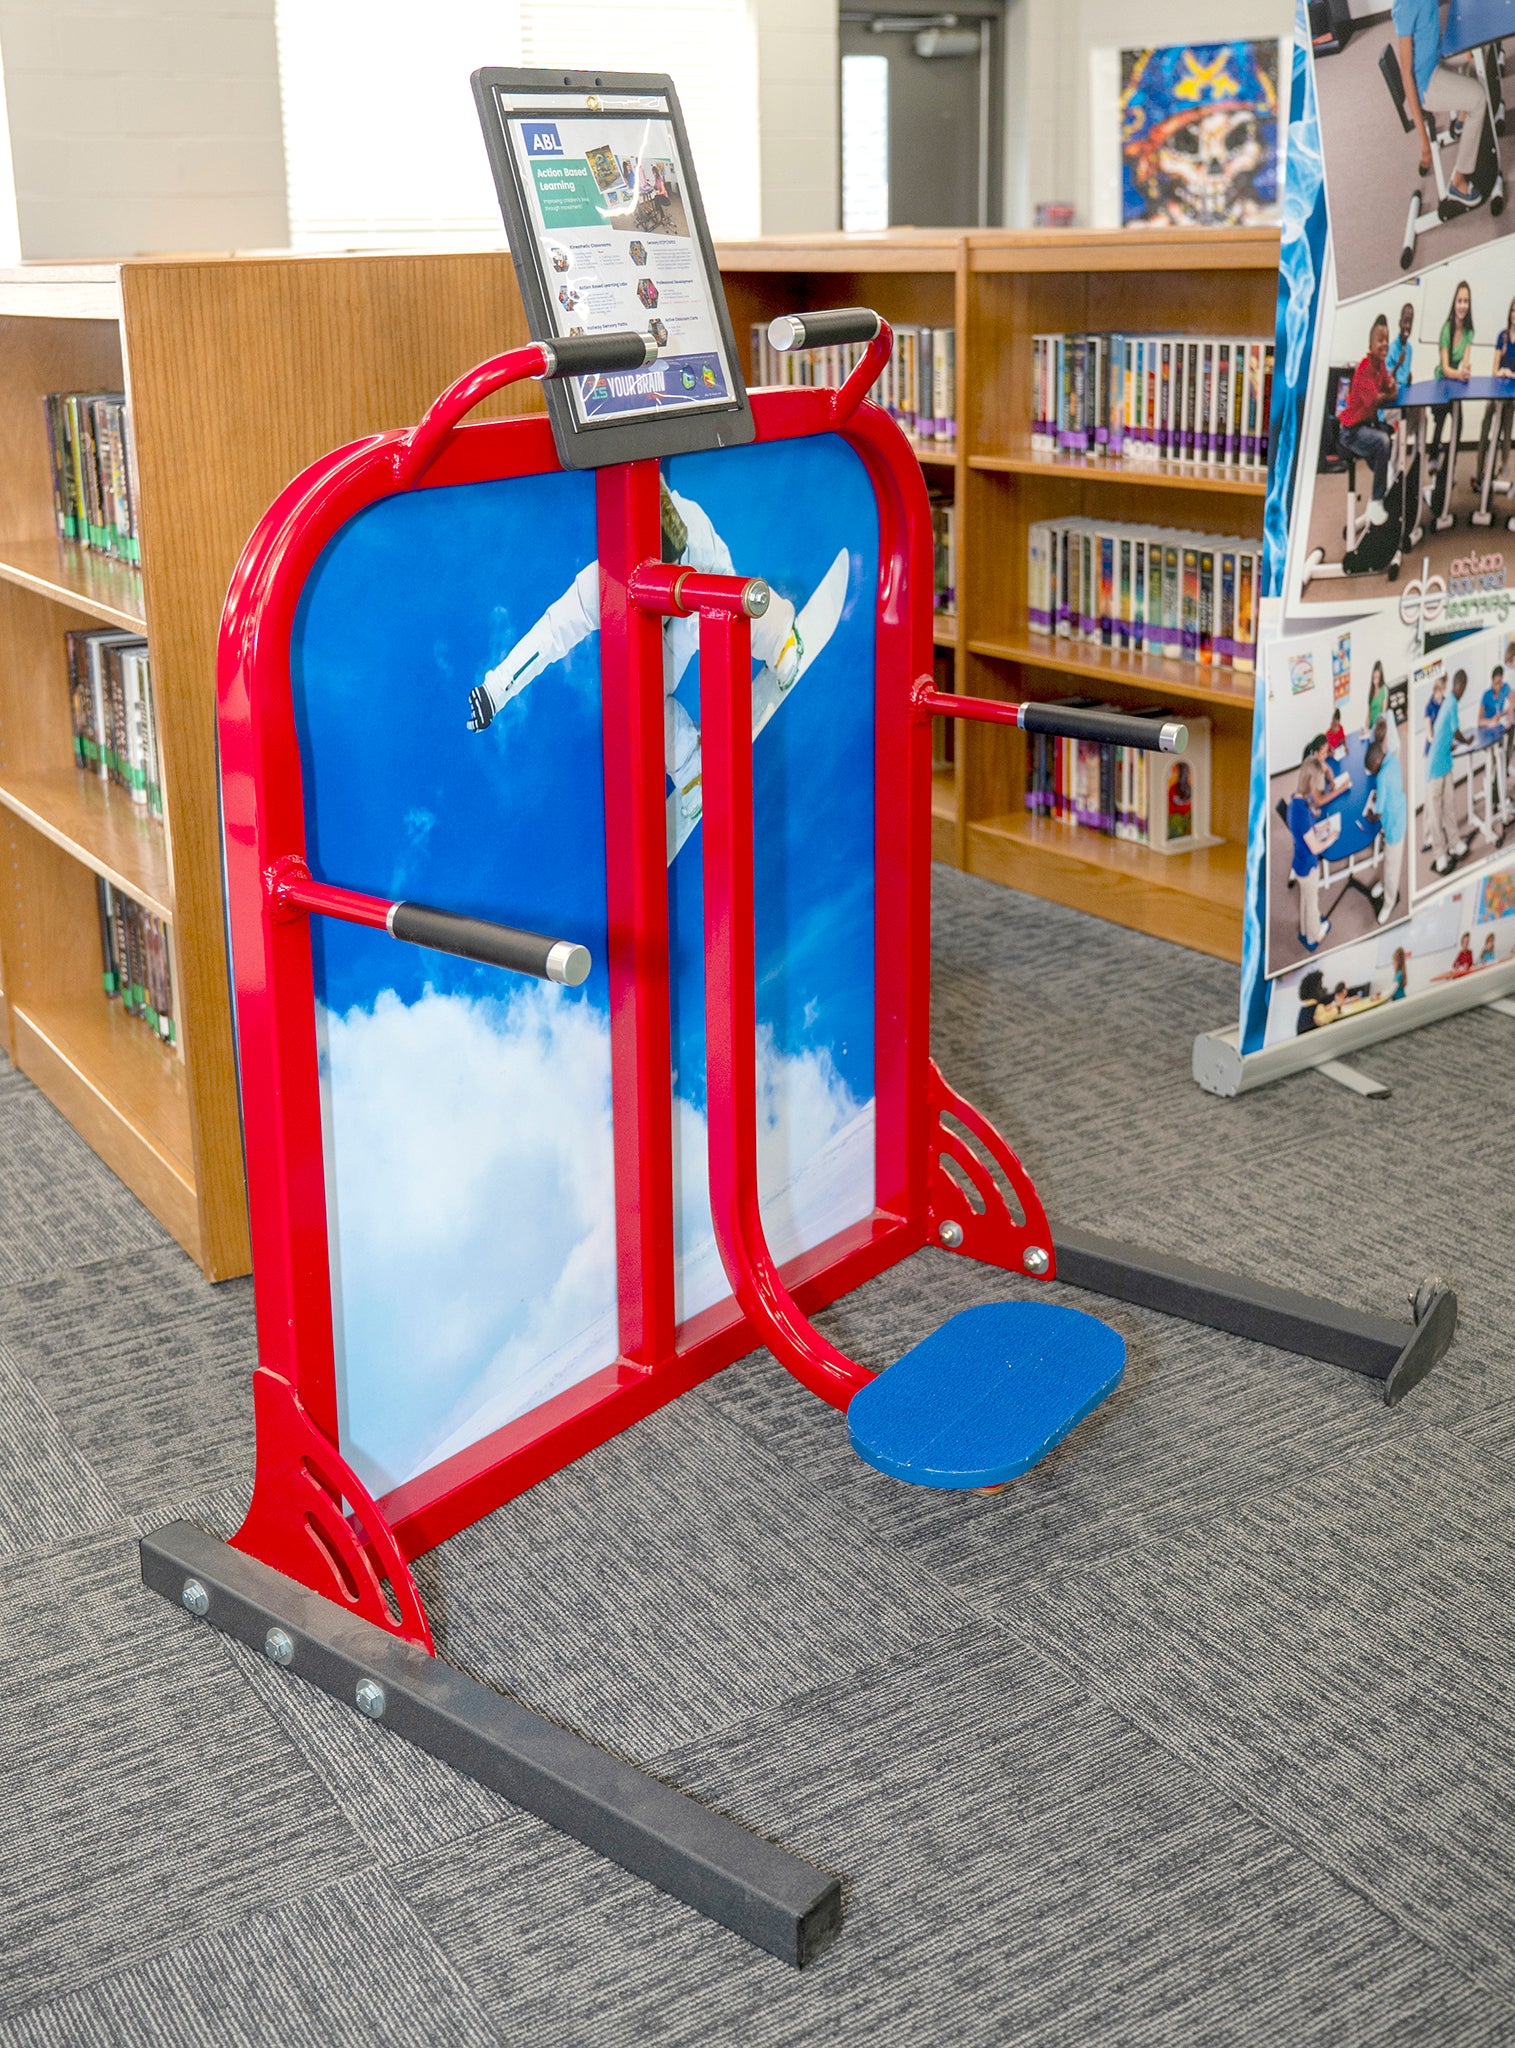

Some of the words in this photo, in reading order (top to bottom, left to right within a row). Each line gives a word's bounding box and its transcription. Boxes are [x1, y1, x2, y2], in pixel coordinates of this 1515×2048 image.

[533, 133, 562, 151] ABL
[537, 167, 563, 178] Action
[564, 167, 588, 177] Based
[540, 180, 576, 192] Learning
[607, 375, 637, 398] YOUR
[637, 372, 665, 392] BRAIN
[592, 386, 608, 400] IS
